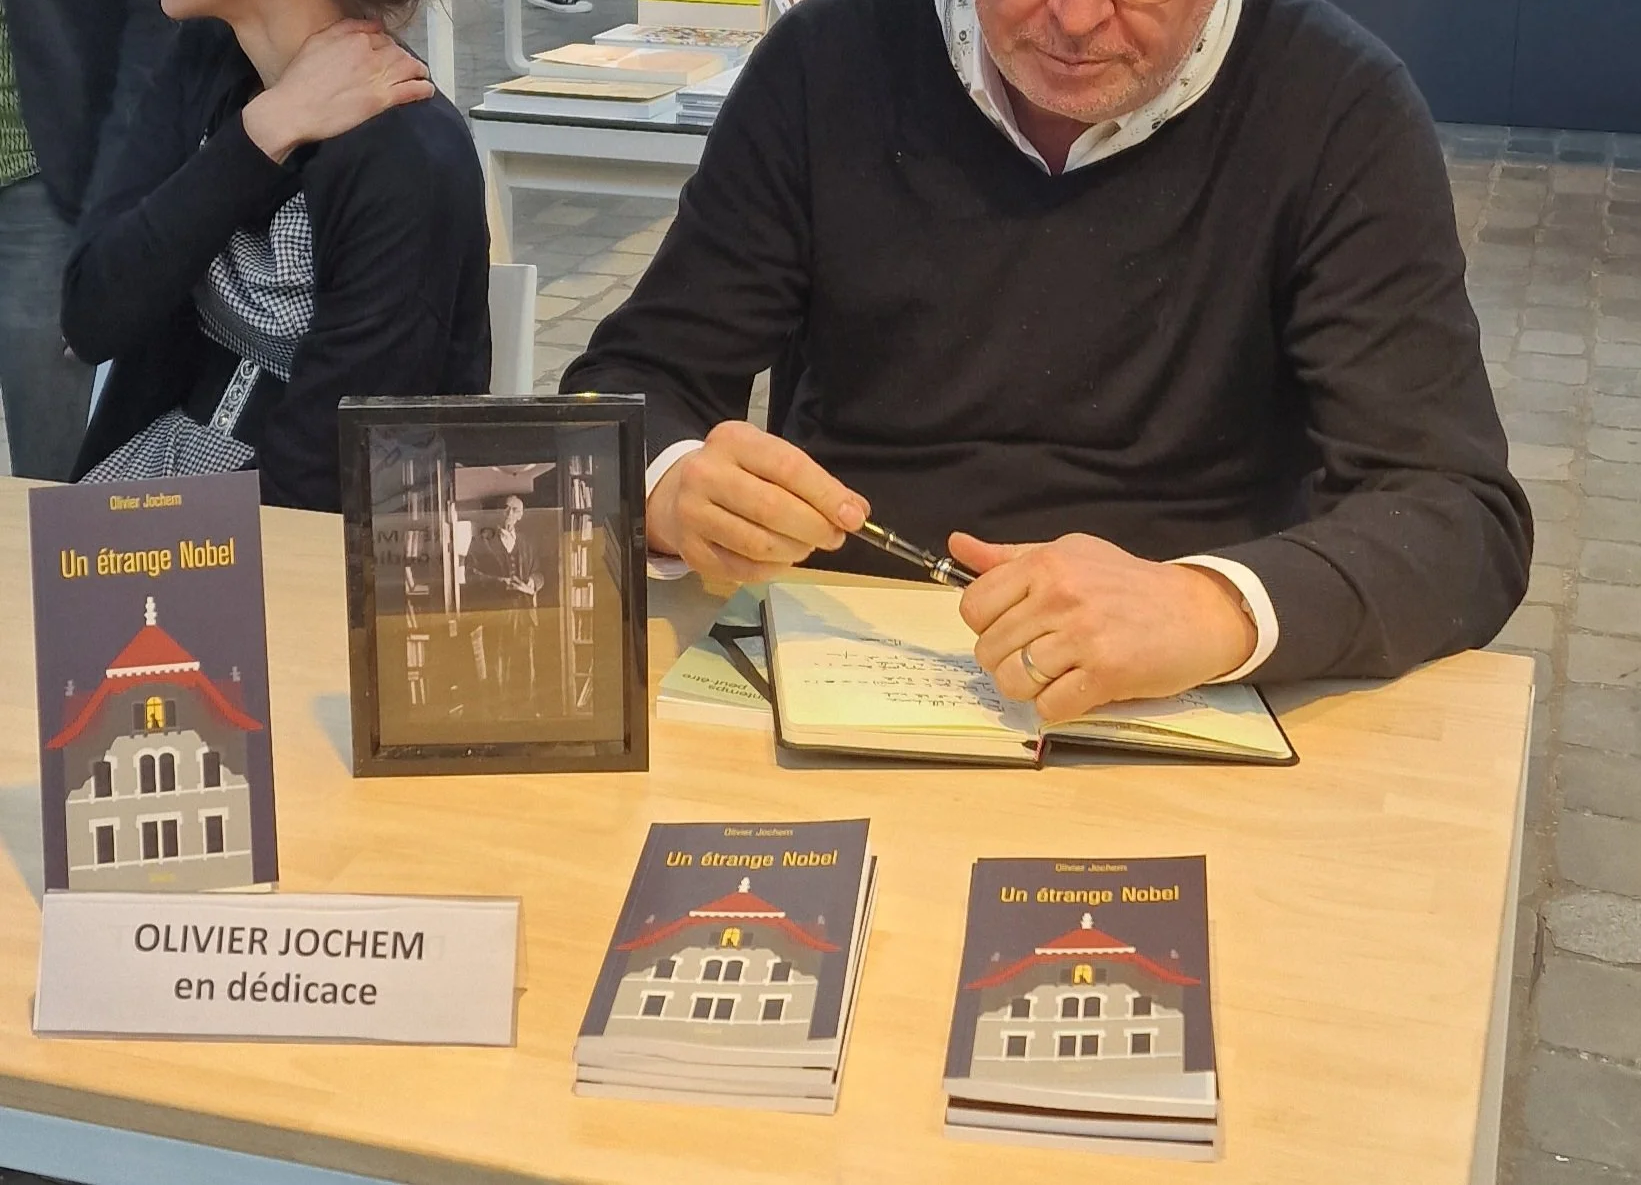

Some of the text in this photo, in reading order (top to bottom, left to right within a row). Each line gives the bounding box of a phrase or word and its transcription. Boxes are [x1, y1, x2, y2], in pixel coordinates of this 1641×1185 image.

[109, 493, 182, 511] Olivier Jochem
[60, 537, 236, 579] Un étrange Nobel
[666, 849, 838, 870] Un étrange Nobel
[1000, 885, 1180, 906] Un étrange Nobel
[134, 922, 426, 961] OLIVIER JOCHEM
[174, 971, 379, 1007] en dédicace
